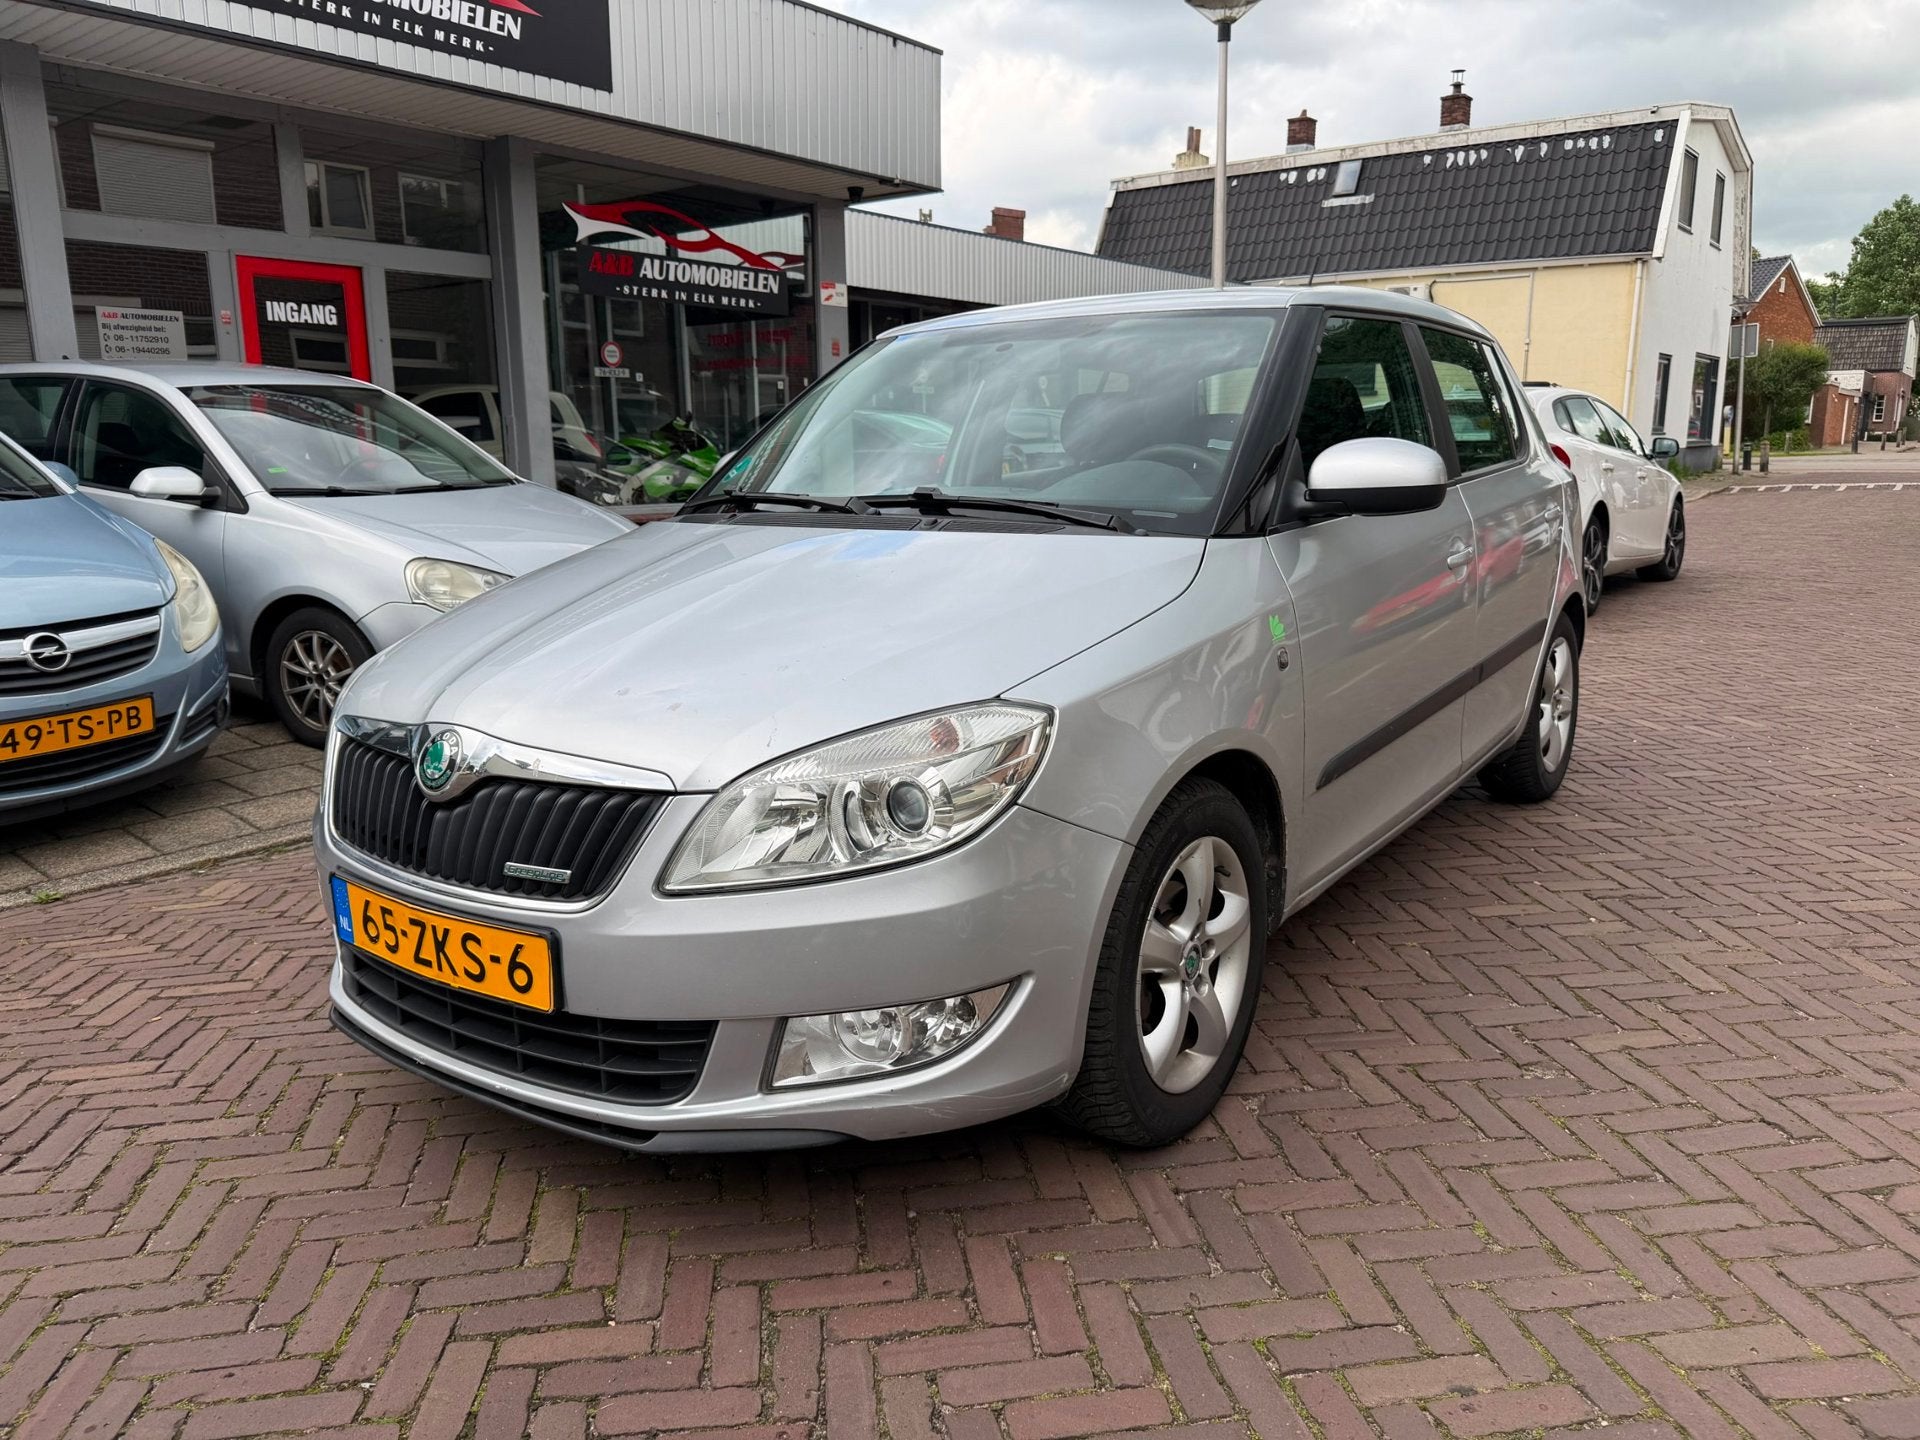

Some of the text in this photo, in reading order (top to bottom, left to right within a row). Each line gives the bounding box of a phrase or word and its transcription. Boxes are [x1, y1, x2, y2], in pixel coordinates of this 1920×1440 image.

[363, 11, 382, 26] IN
[392, 18, 424, 37] ELK
[434, 29, 494, 52] MERK-
[588, 252, 780, 294] A&B AUTOMOBIELEN
[616, 285, 762, 308] -STERK IN ELK MERK-
[101, 311, 179, 322] A&B AUTOMOBIELEN
[265, 300, 338, 326] INGANG
[101, 323, 112, 331] Bij
[113, 323, 153, 333] afwezigheid
[339, 914, 352, 932] NL
[362, 900, 534, 994] 65-ZKS-6
